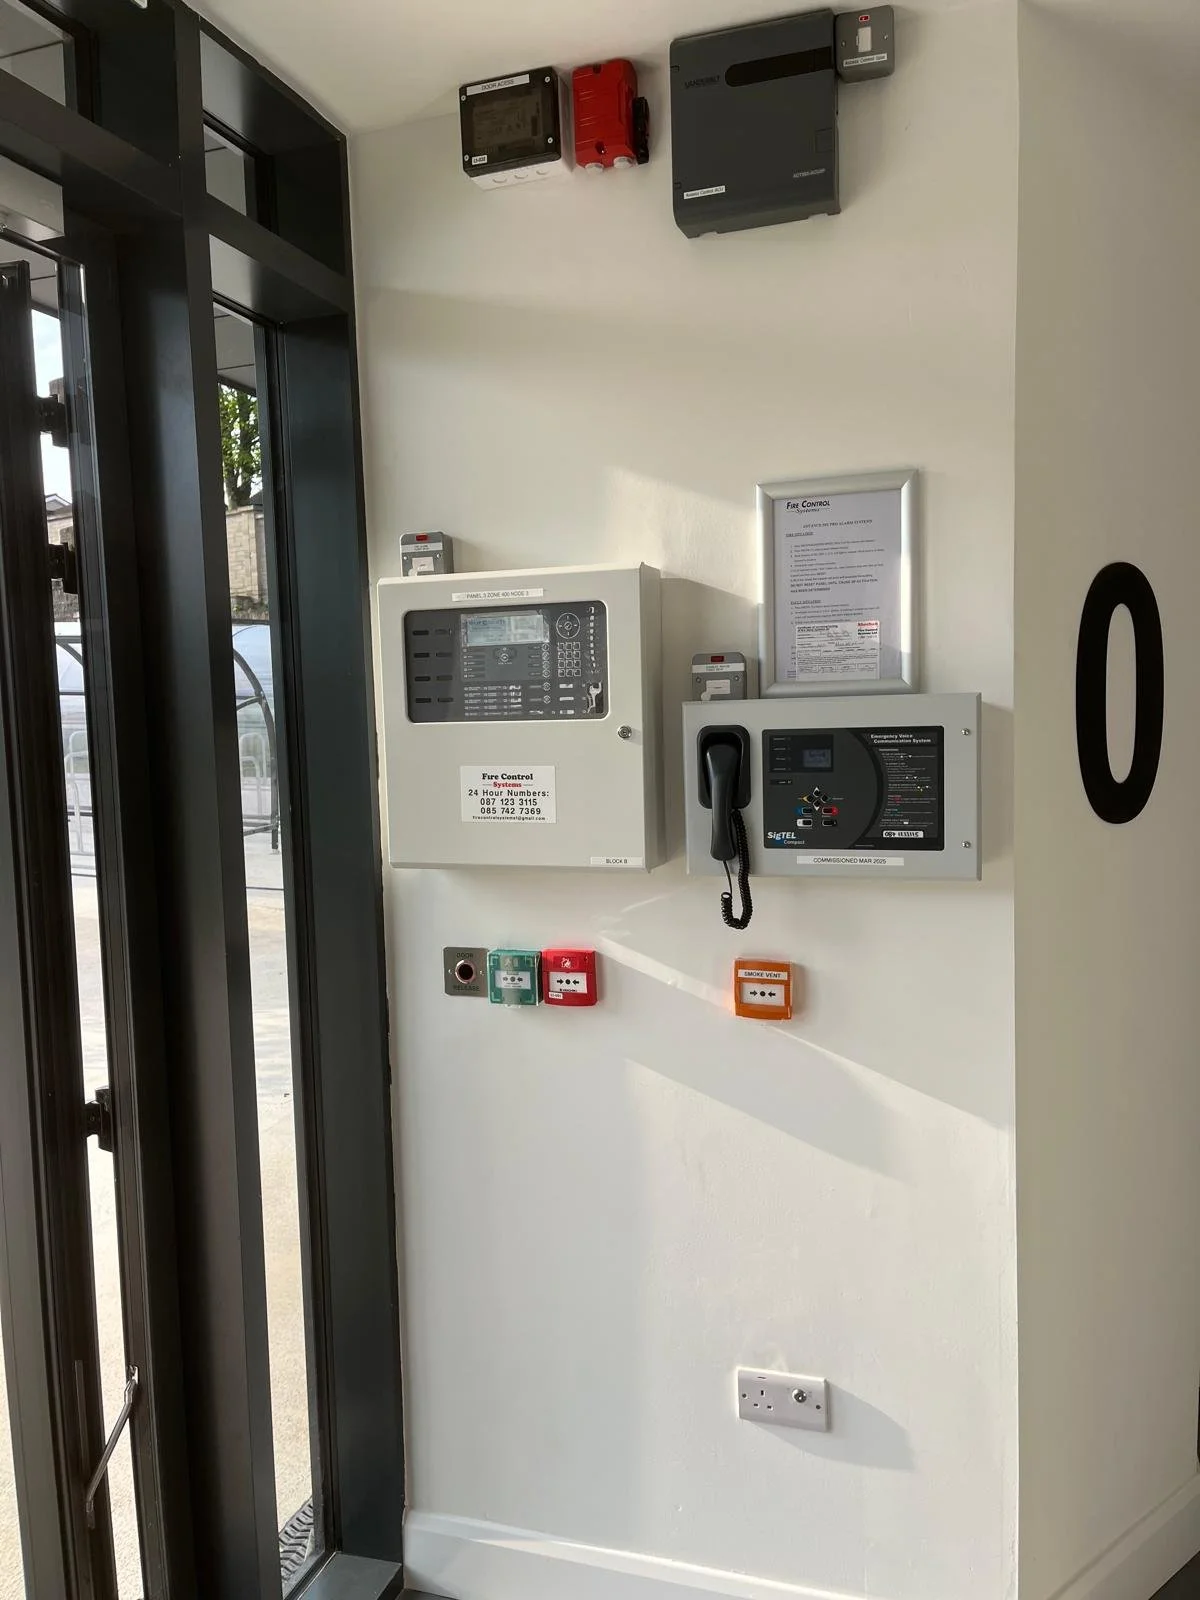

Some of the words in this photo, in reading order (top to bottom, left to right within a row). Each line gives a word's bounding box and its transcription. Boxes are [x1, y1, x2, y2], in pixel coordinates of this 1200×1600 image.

[481, 83, 497, 91] DOOR
[482, 789, 503, 797] Hour
[507, 789, 549, 797] Numbers:
[480, 797, 496, 806] 087
[500, 798, 515, 806] 123
[518, 798, 538, 806] 3115
[480, 807, 497, 815] 085
[500, 807, 516, 815] 742
[519, 807, 541, 815] 7369
[767, 831, 797, 840] SigTEL
